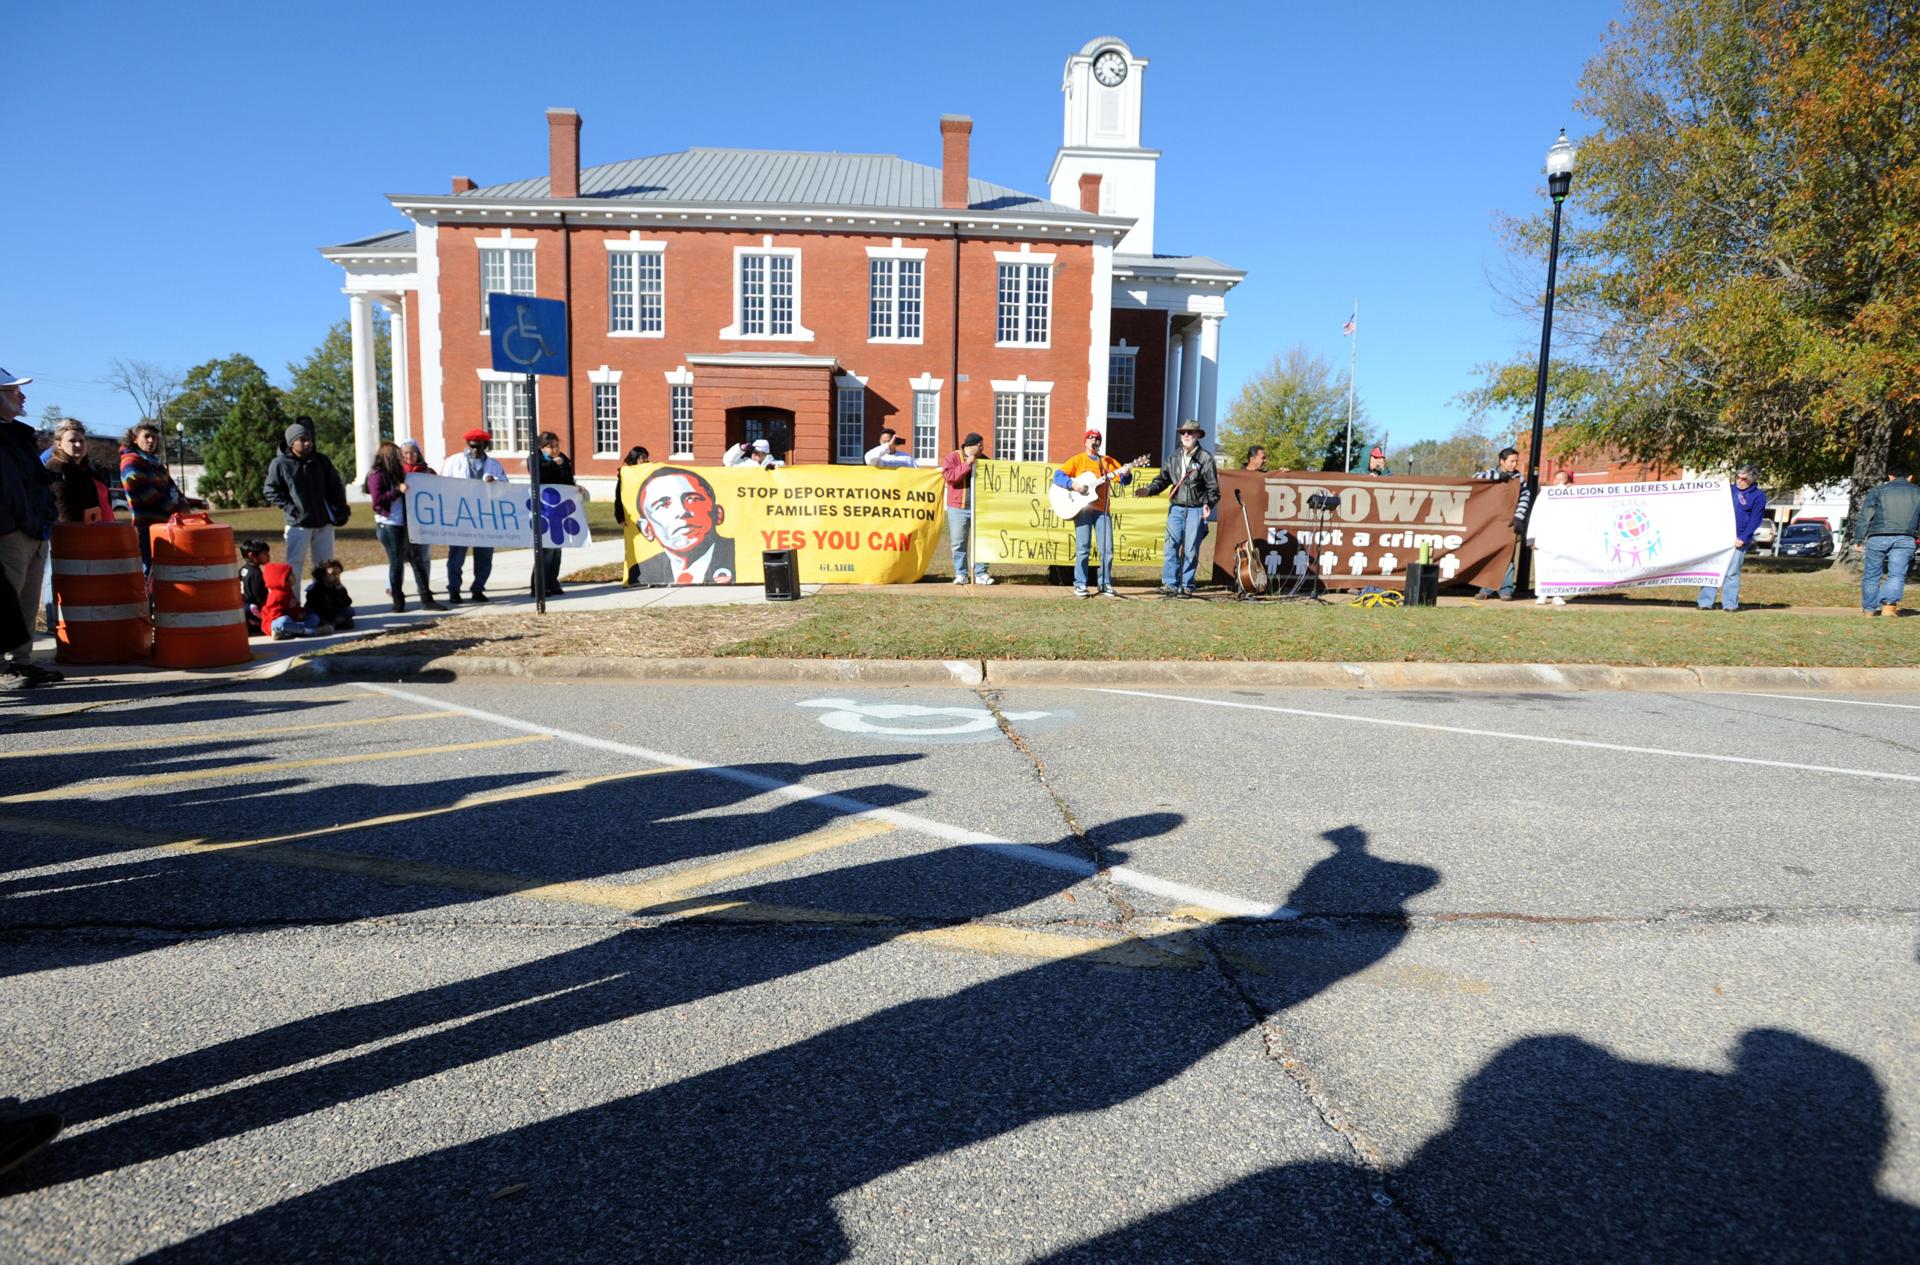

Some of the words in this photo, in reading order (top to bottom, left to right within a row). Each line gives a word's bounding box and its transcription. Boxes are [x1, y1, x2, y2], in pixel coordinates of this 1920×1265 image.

[737, 486, 779, 499] STOP
[784, 487, 901, 501] DEPORTATIONS
[906, 490, 936, 503] AND
[1547, 487, 1604, 497] COALICION
[1608, 486, 1621, 495] DE
[1624, 483, 1669, 494] LIDERES
[1672, 480, 1721, 491] LATINOS
[414, 491, 520, 530] GLAHR
[766, 504, 839, 517] FAMILIES
[843, 505, 935, 521] SEPARATION
[1264, 483, 1471, 526] BROWN
[761, 530, 806, 550] YES
[814, 530, 860, 551] YOU
[868, 531, 912, 552] CAN
[1267, 527, 1289, 546] is
[1297, 528, 1343, 547] not
[1351, 532, 1371, 548] a
[1379, 530, 1463, 550] crime
[819, 563, 855, 572] GLAHR
[1674, 577, 1719, 586] COMMODITIES
